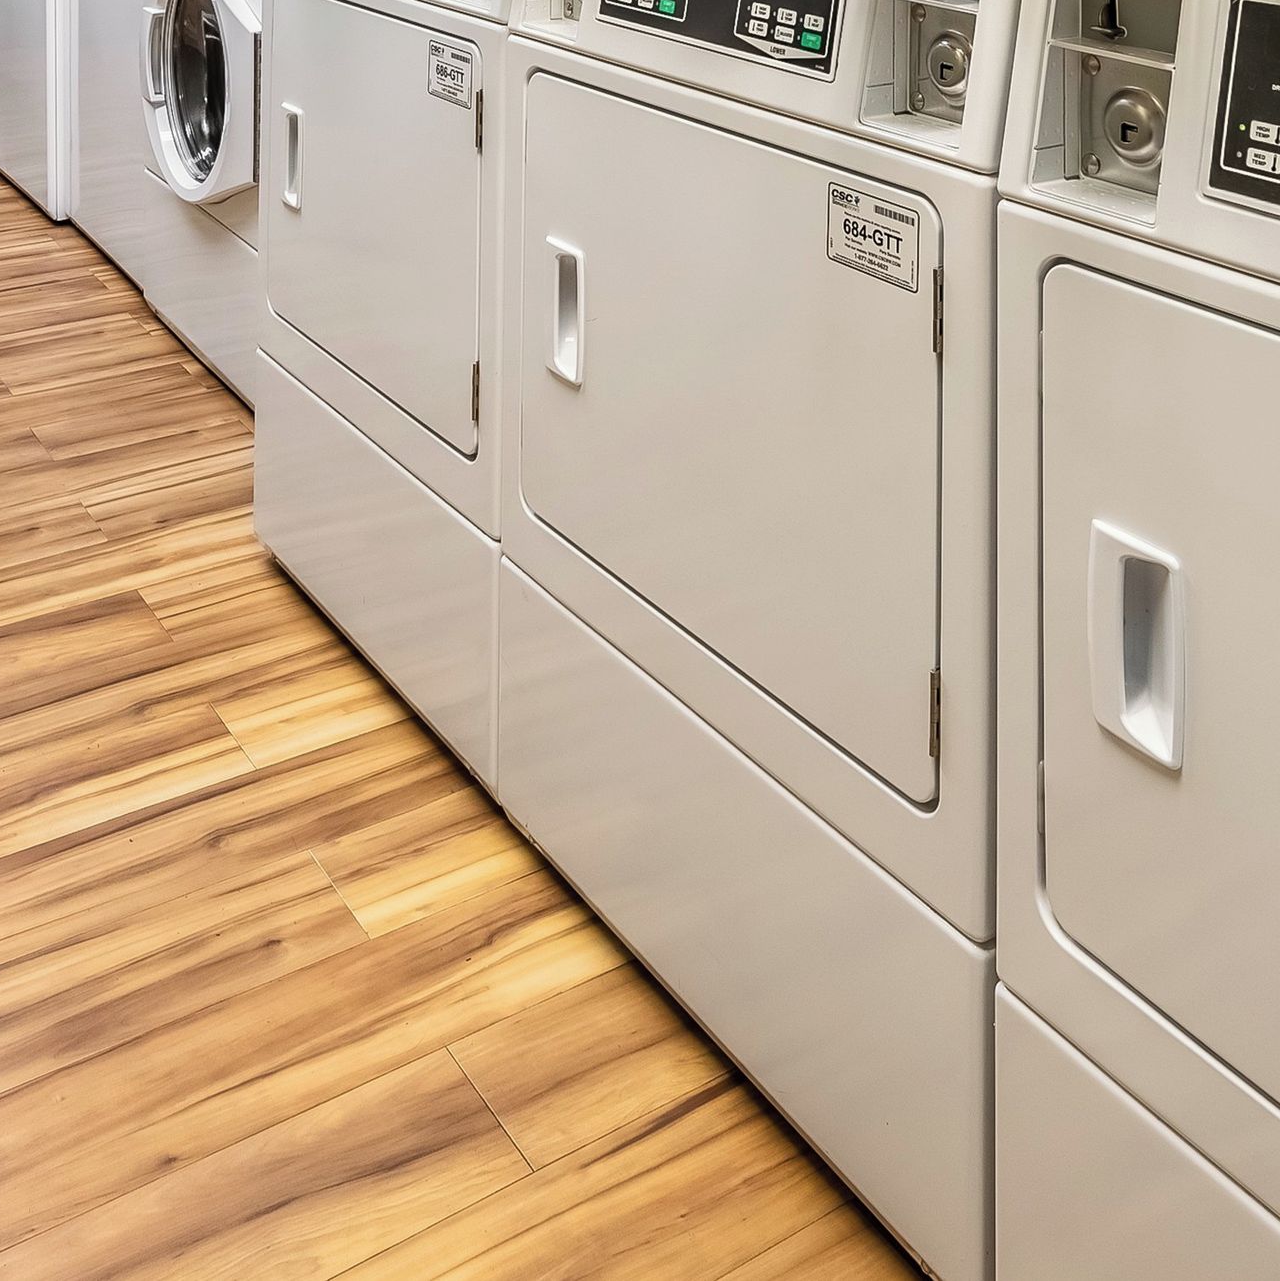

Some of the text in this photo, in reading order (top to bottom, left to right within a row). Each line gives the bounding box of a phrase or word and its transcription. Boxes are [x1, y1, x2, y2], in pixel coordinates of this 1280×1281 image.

[770, 46, 785, 55] LOWER
[832, 189, 853, 202] CSC
[843, 218, 902, 253] 684-GTT
